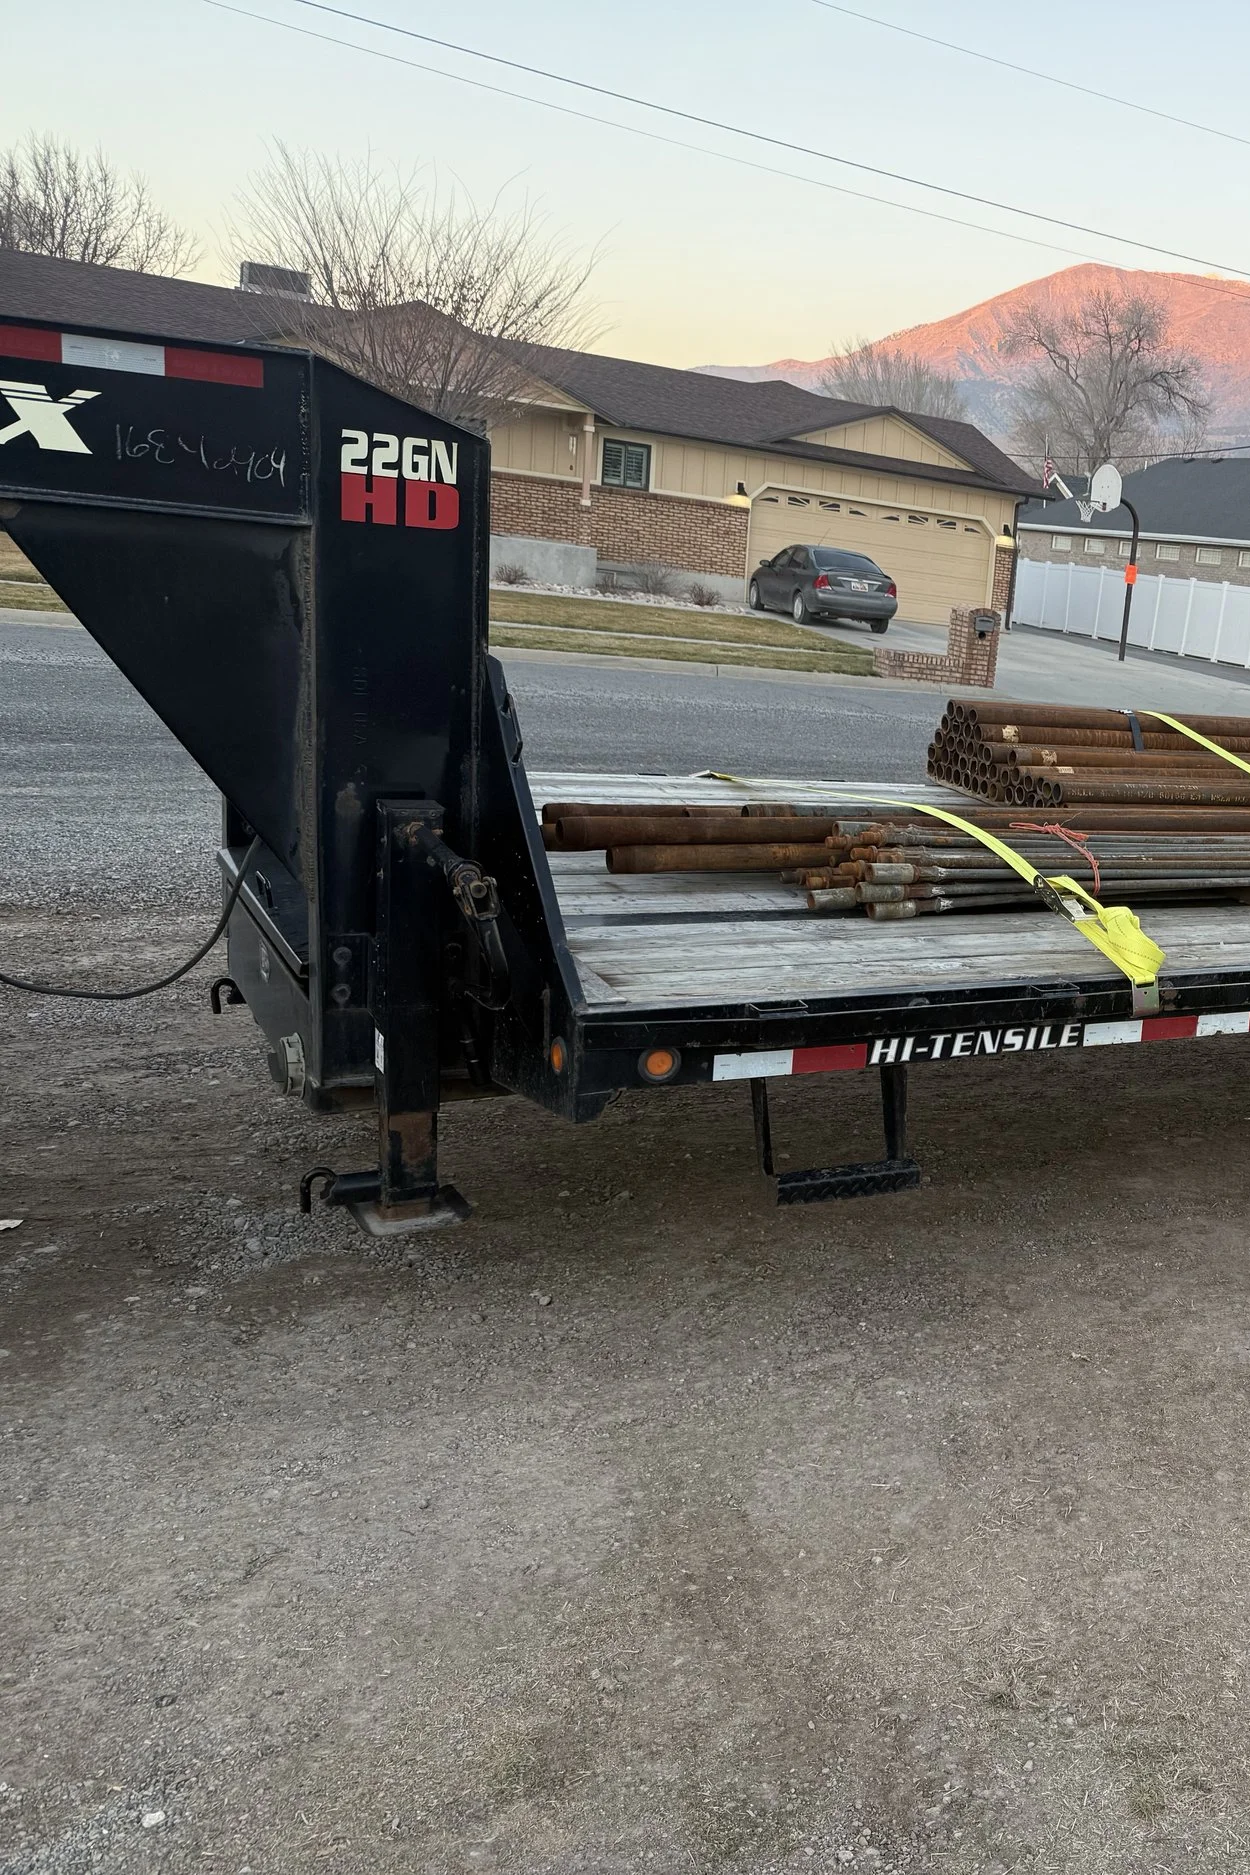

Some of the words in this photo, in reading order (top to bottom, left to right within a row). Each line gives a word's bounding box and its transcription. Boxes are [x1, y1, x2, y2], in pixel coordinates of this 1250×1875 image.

[340, 428, 459, 485] 22GN
[340, 472, 460, 530] HD
[868, 1023, 1082, 1066] HI-TENSILE
